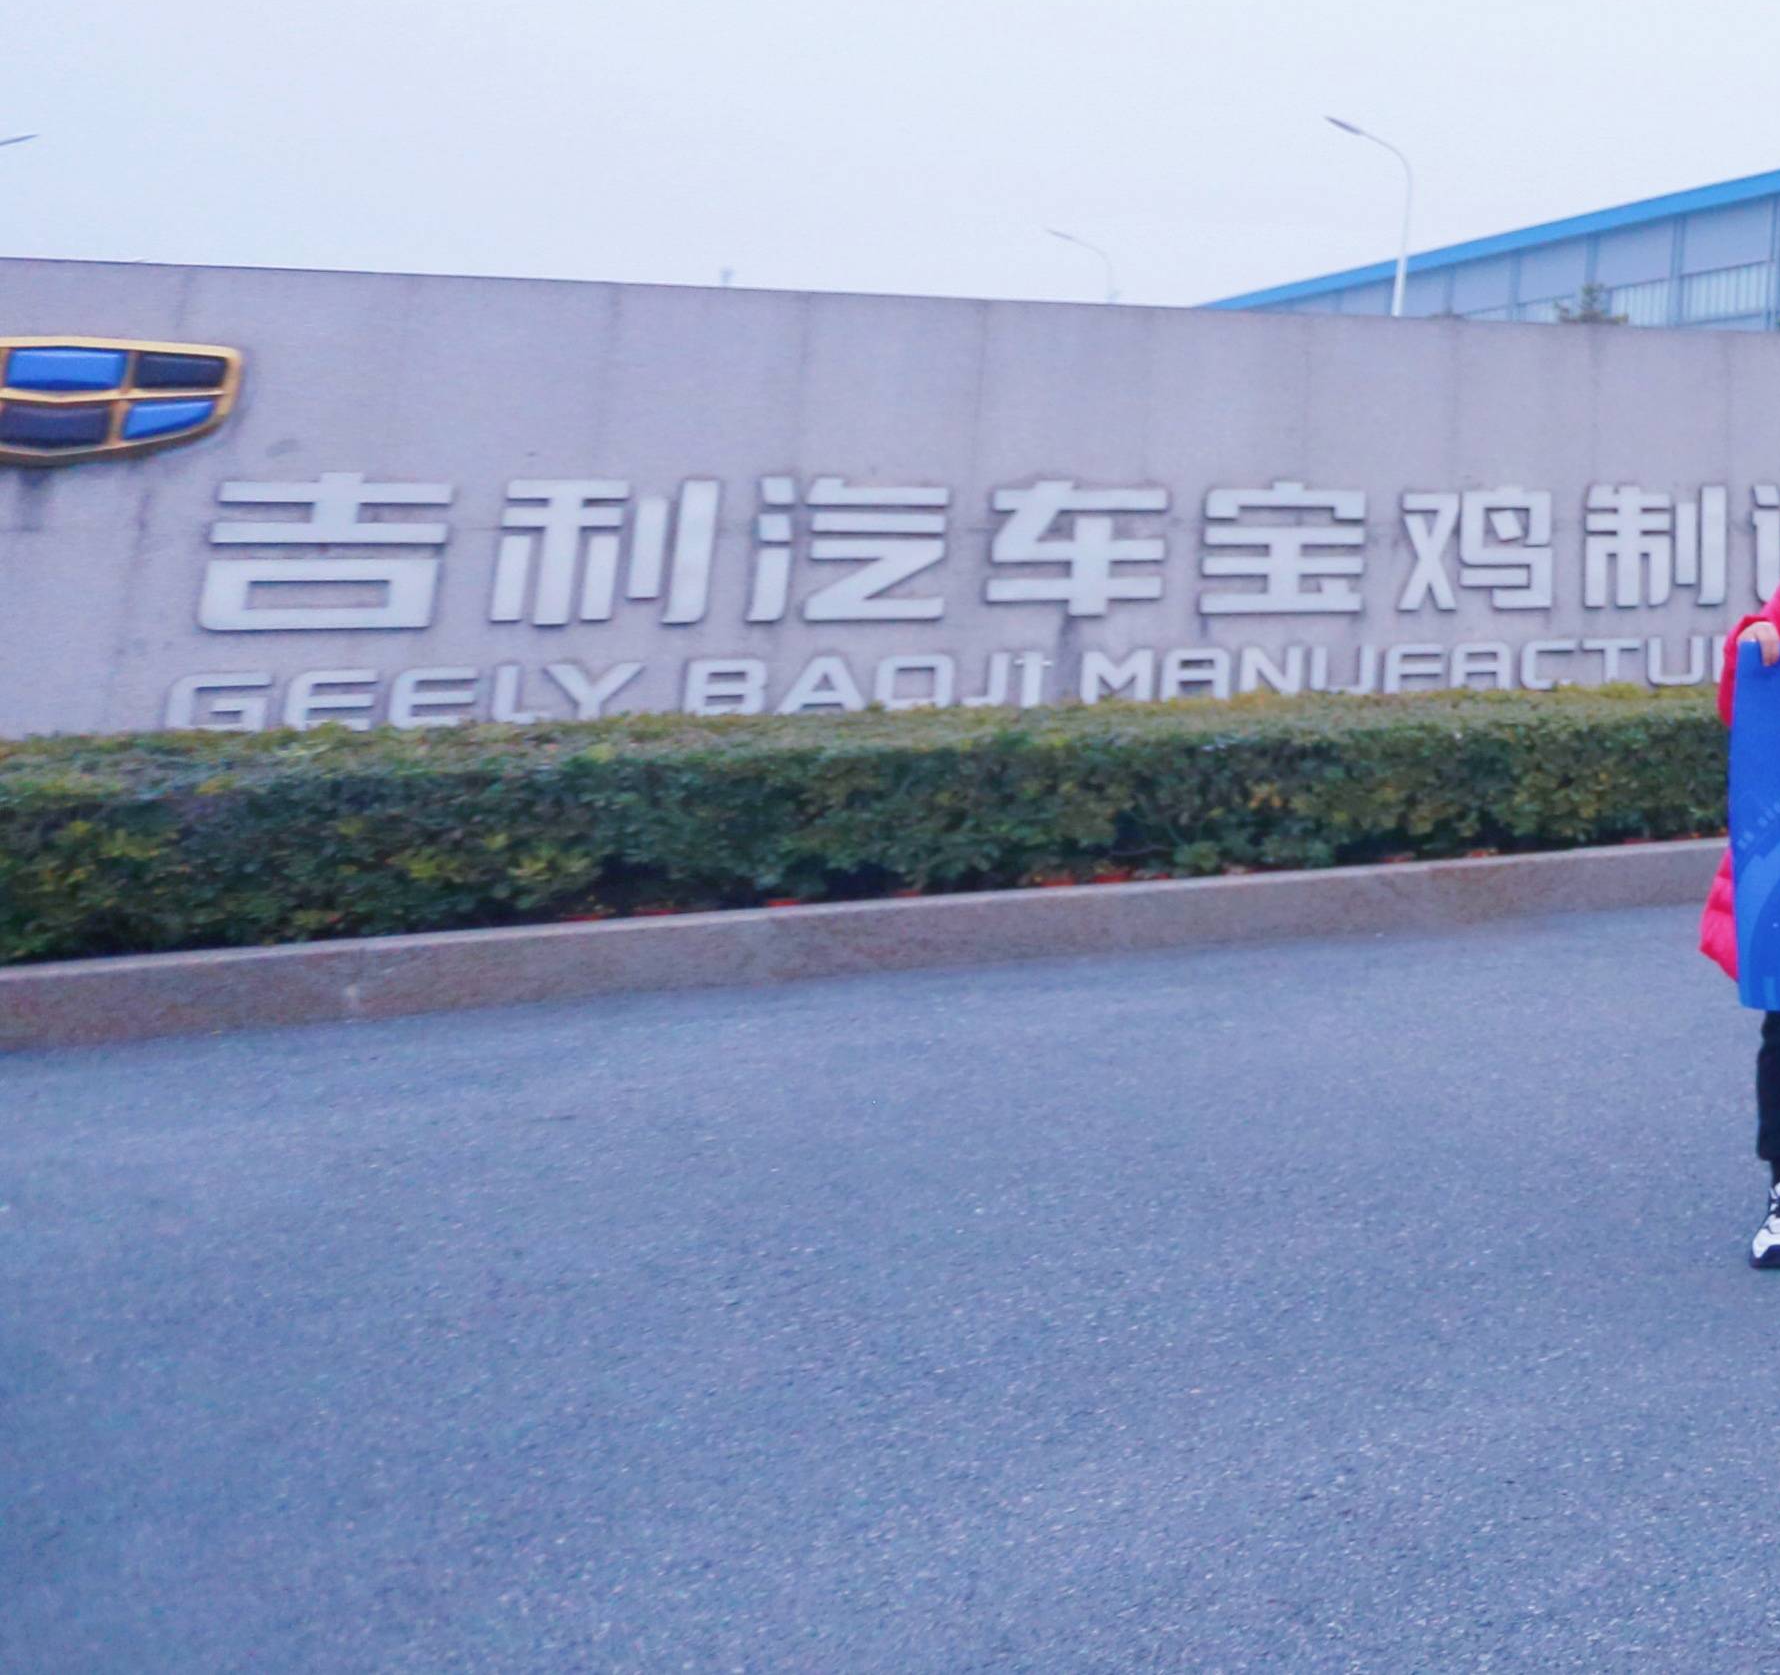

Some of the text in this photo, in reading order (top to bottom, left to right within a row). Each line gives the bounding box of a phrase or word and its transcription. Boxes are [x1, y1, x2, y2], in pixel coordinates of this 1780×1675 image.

[167, 635, 1727, 731] GEELY BAOJI MANUFACTU
